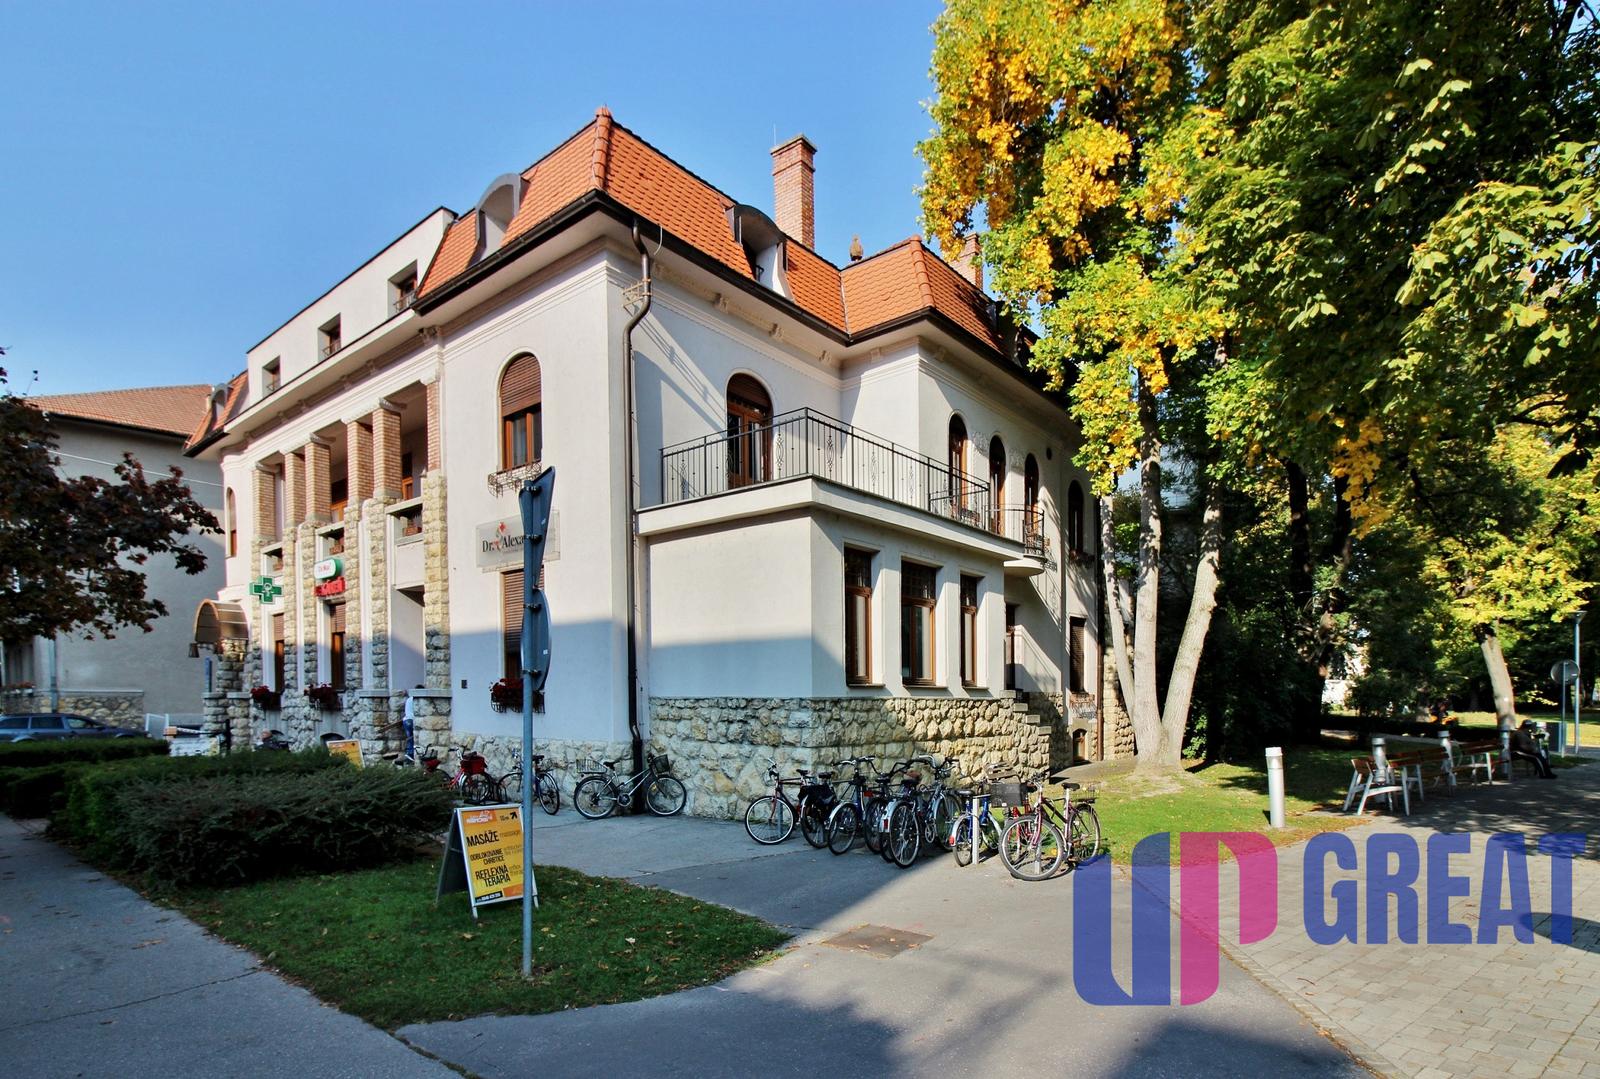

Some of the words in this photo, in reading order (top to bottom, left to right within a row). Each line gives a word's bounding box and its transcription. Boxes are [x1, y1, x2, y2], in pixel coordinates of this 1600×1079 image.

[482, 539, 495, 553] Dr.
[502, 534, 525, 549] Alexa
[466, 830, 500, 847] MASÁŽE
[475, 864, 509, 880] REFLEXNÁ
[484, 874, 511, 888] TERAPIA
